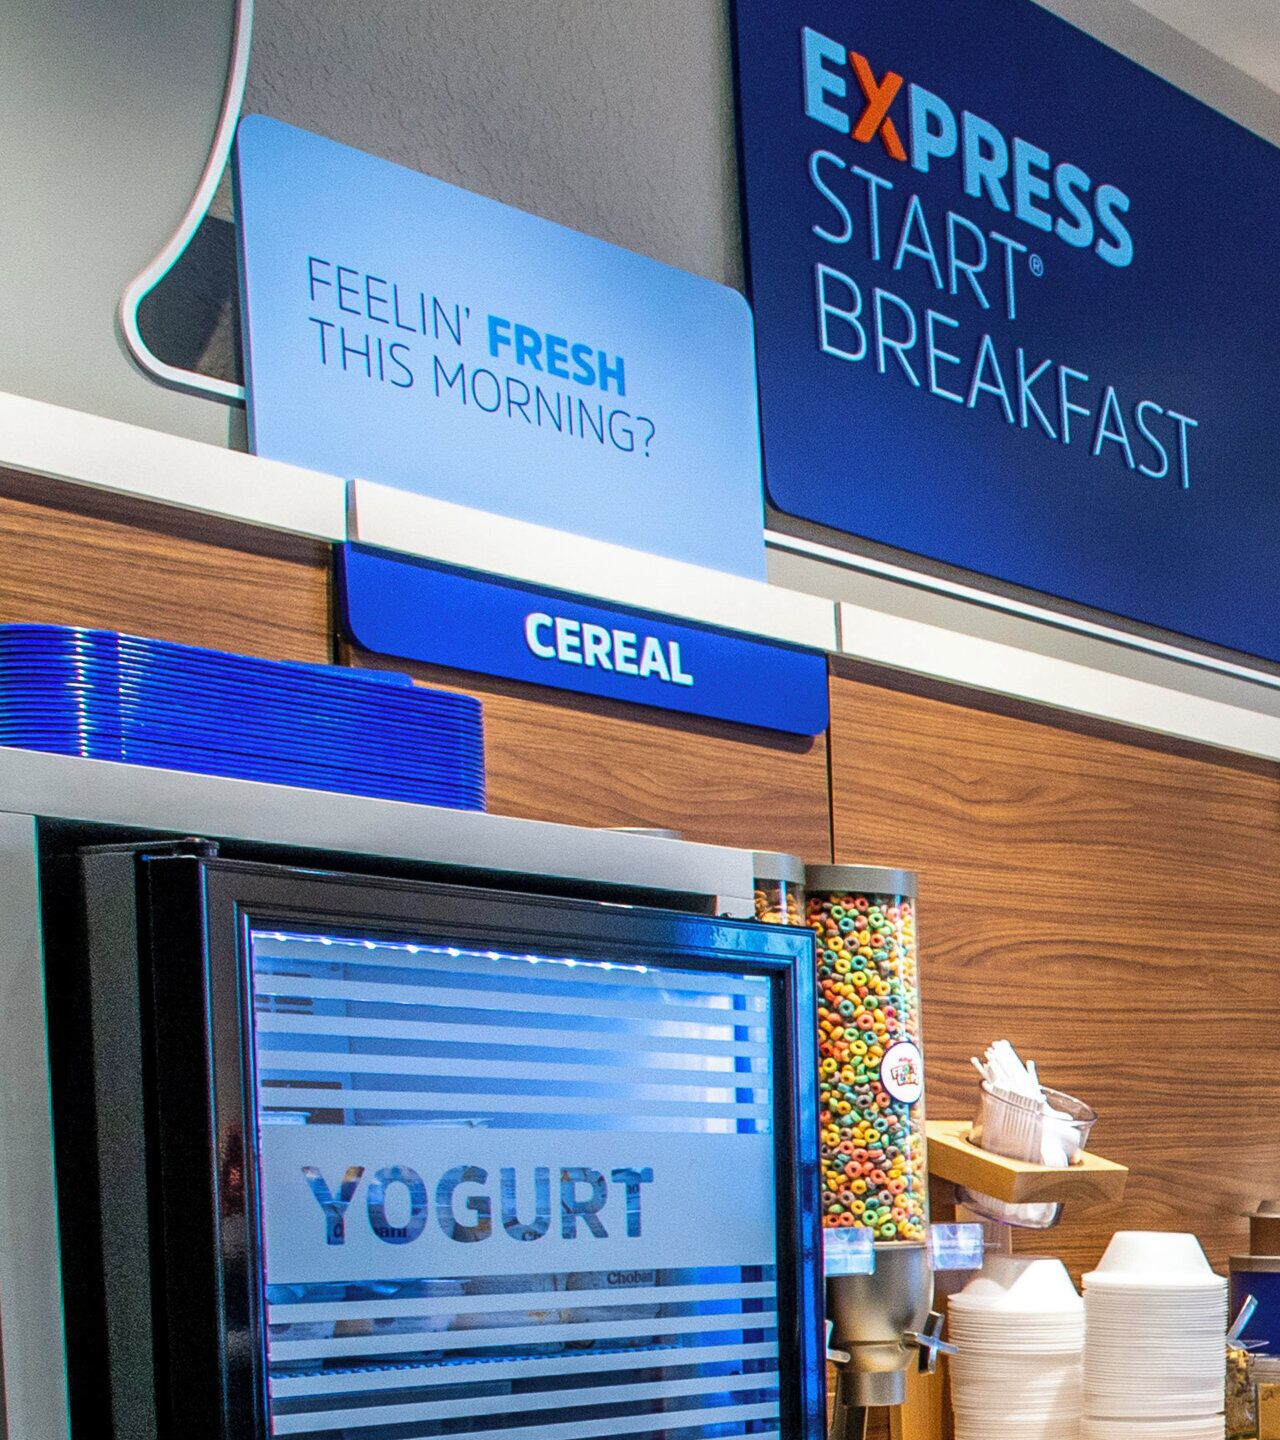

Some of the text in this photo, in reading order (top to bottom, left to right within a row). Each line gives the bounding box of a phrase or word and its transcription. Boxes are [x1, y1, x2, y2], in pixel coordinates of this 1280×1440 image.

[801, 25, 1134, 268] EXPRESS
[308, 316, 657, 458] THIS MORNING?
[487, 314, 627, 397] FRESH
[812, 262, 1198, 490] BREAKFAST
[524, 611, 694, 687] CEREAL
[301, 1165, 655, 1246] YOGURT
